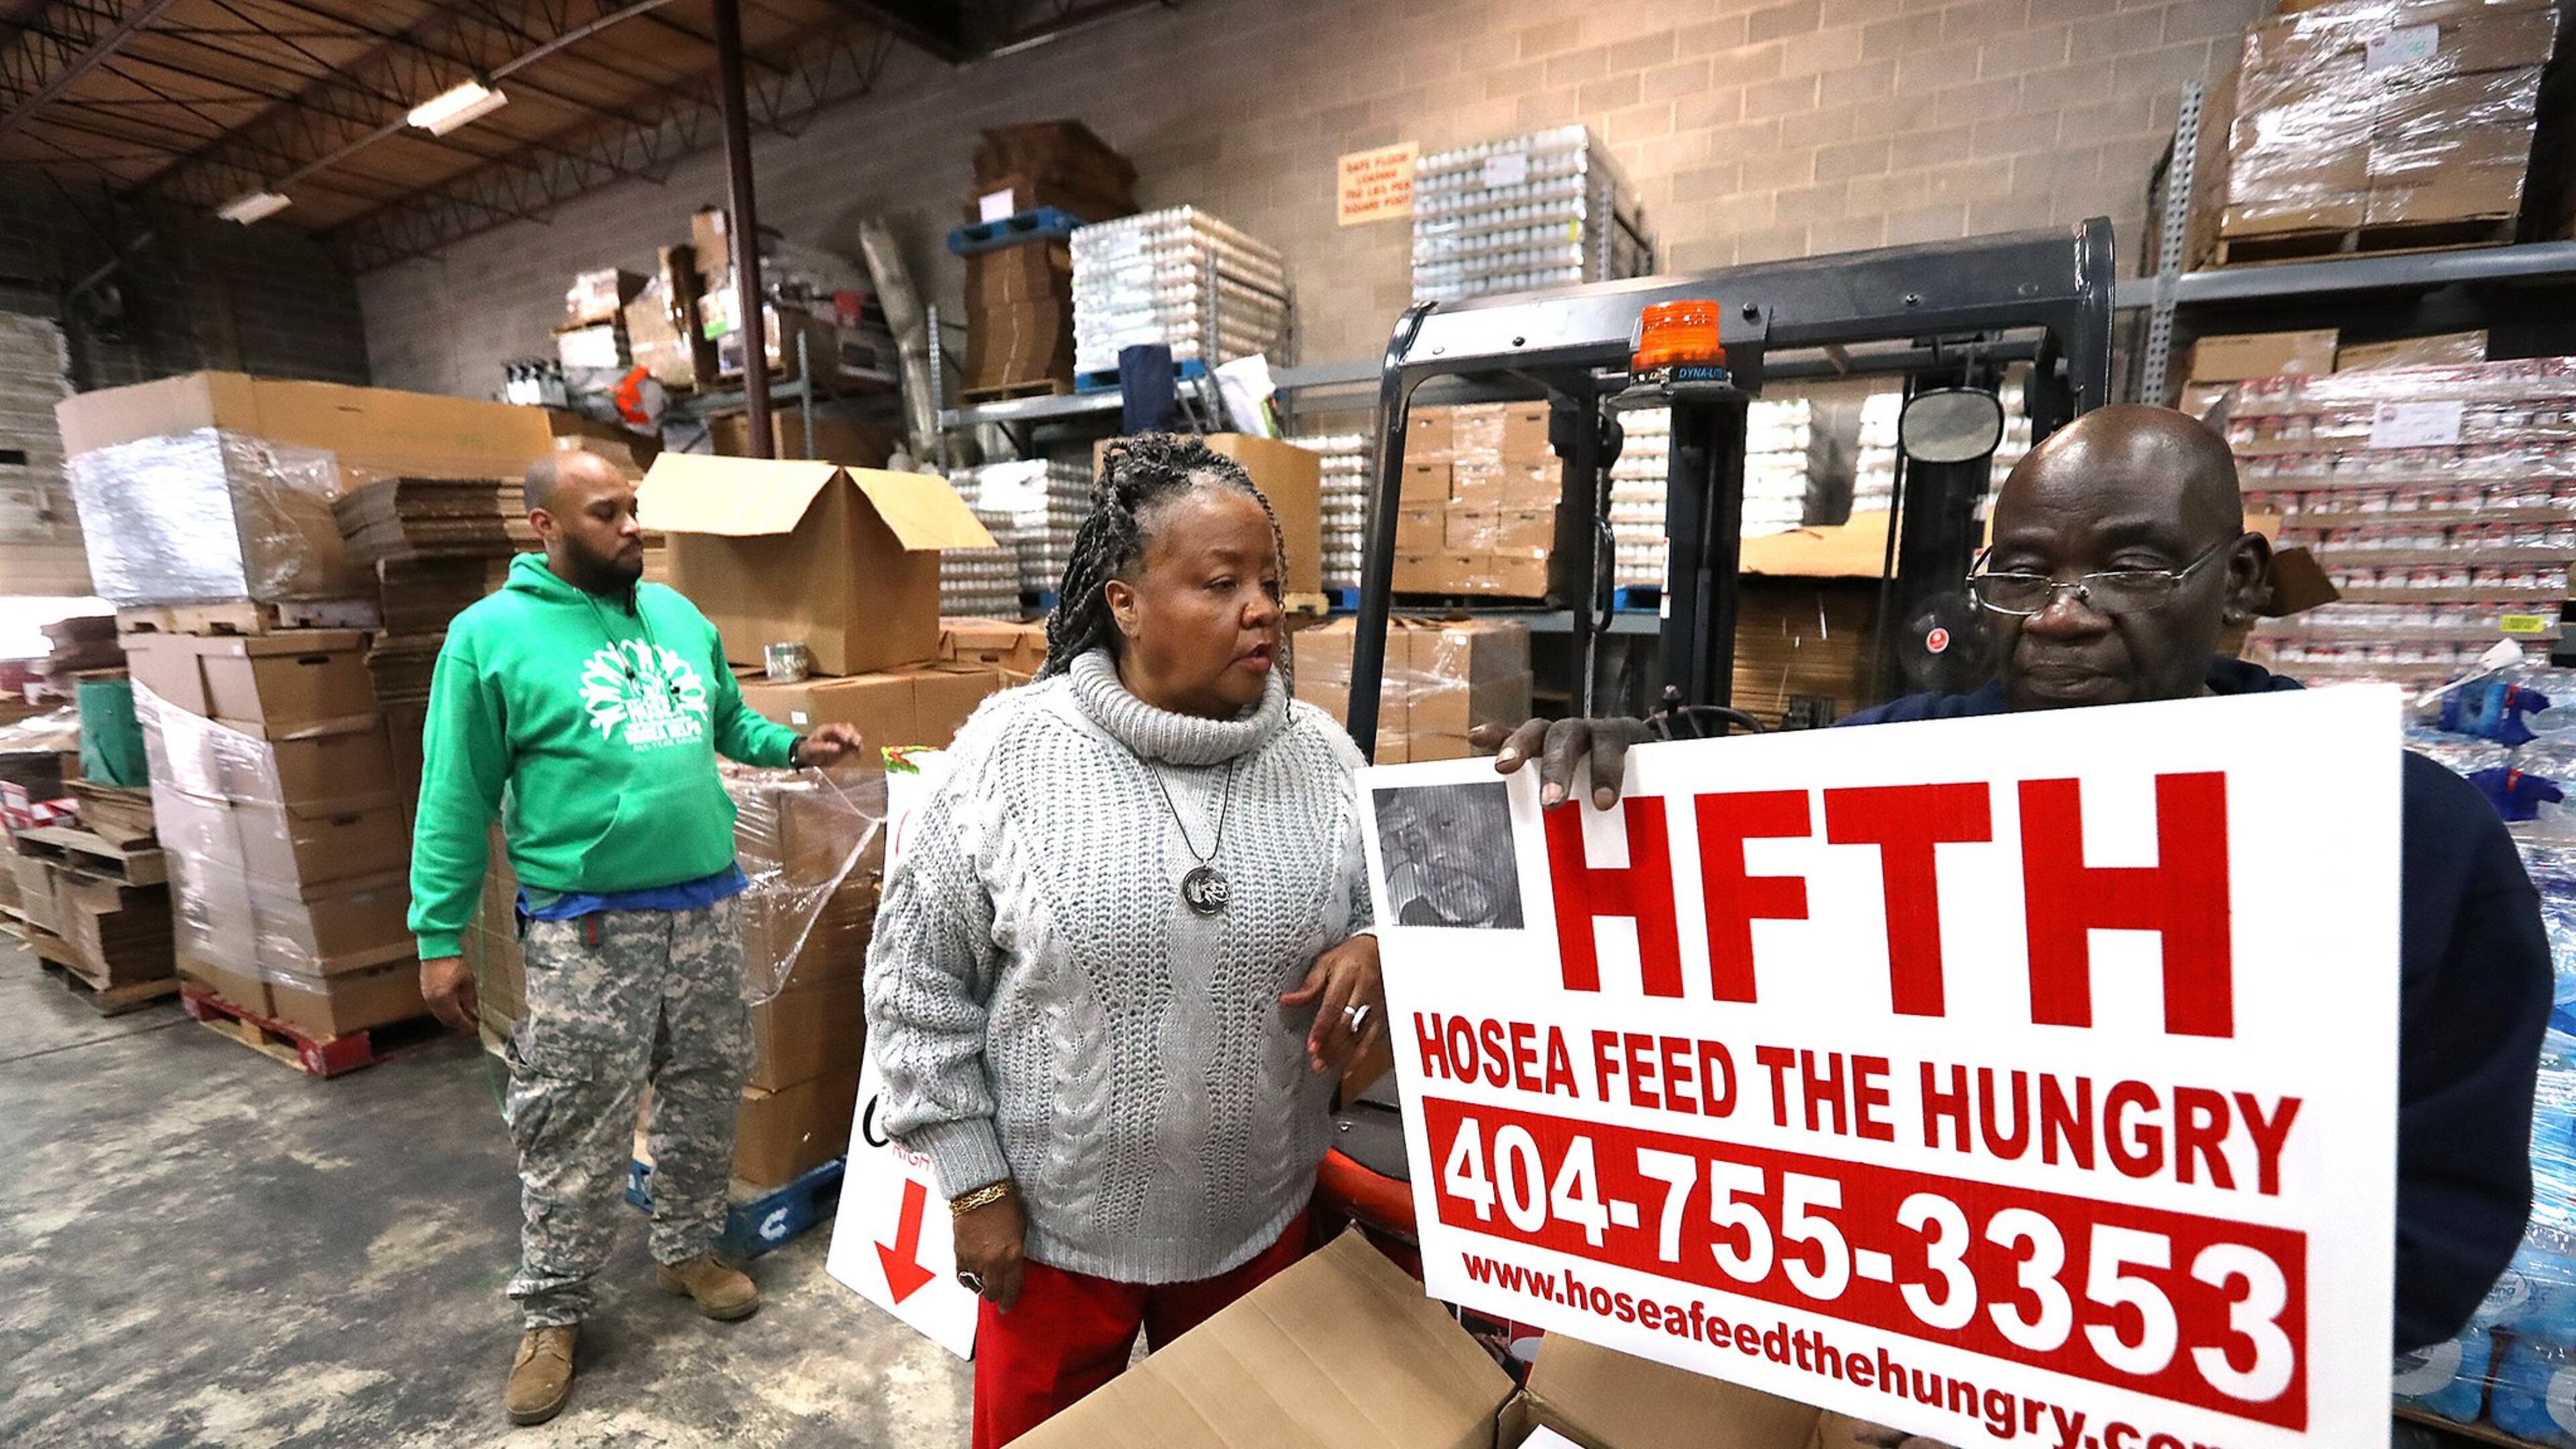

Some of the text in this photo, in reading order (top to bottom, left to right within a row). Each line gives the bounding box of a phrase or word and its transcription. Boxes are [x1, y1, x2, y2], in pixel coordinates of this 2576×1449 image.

[1544, 771, 2234, 1038] HFTH
[1413, 1012, 2302, 1196] HOSEA FEED THE HUNGRY
[1444, 1116, 2295, 1403] 404-755-3353
[1462, 1252, 2229, 1449] www.hoseafeedthehungry.c
